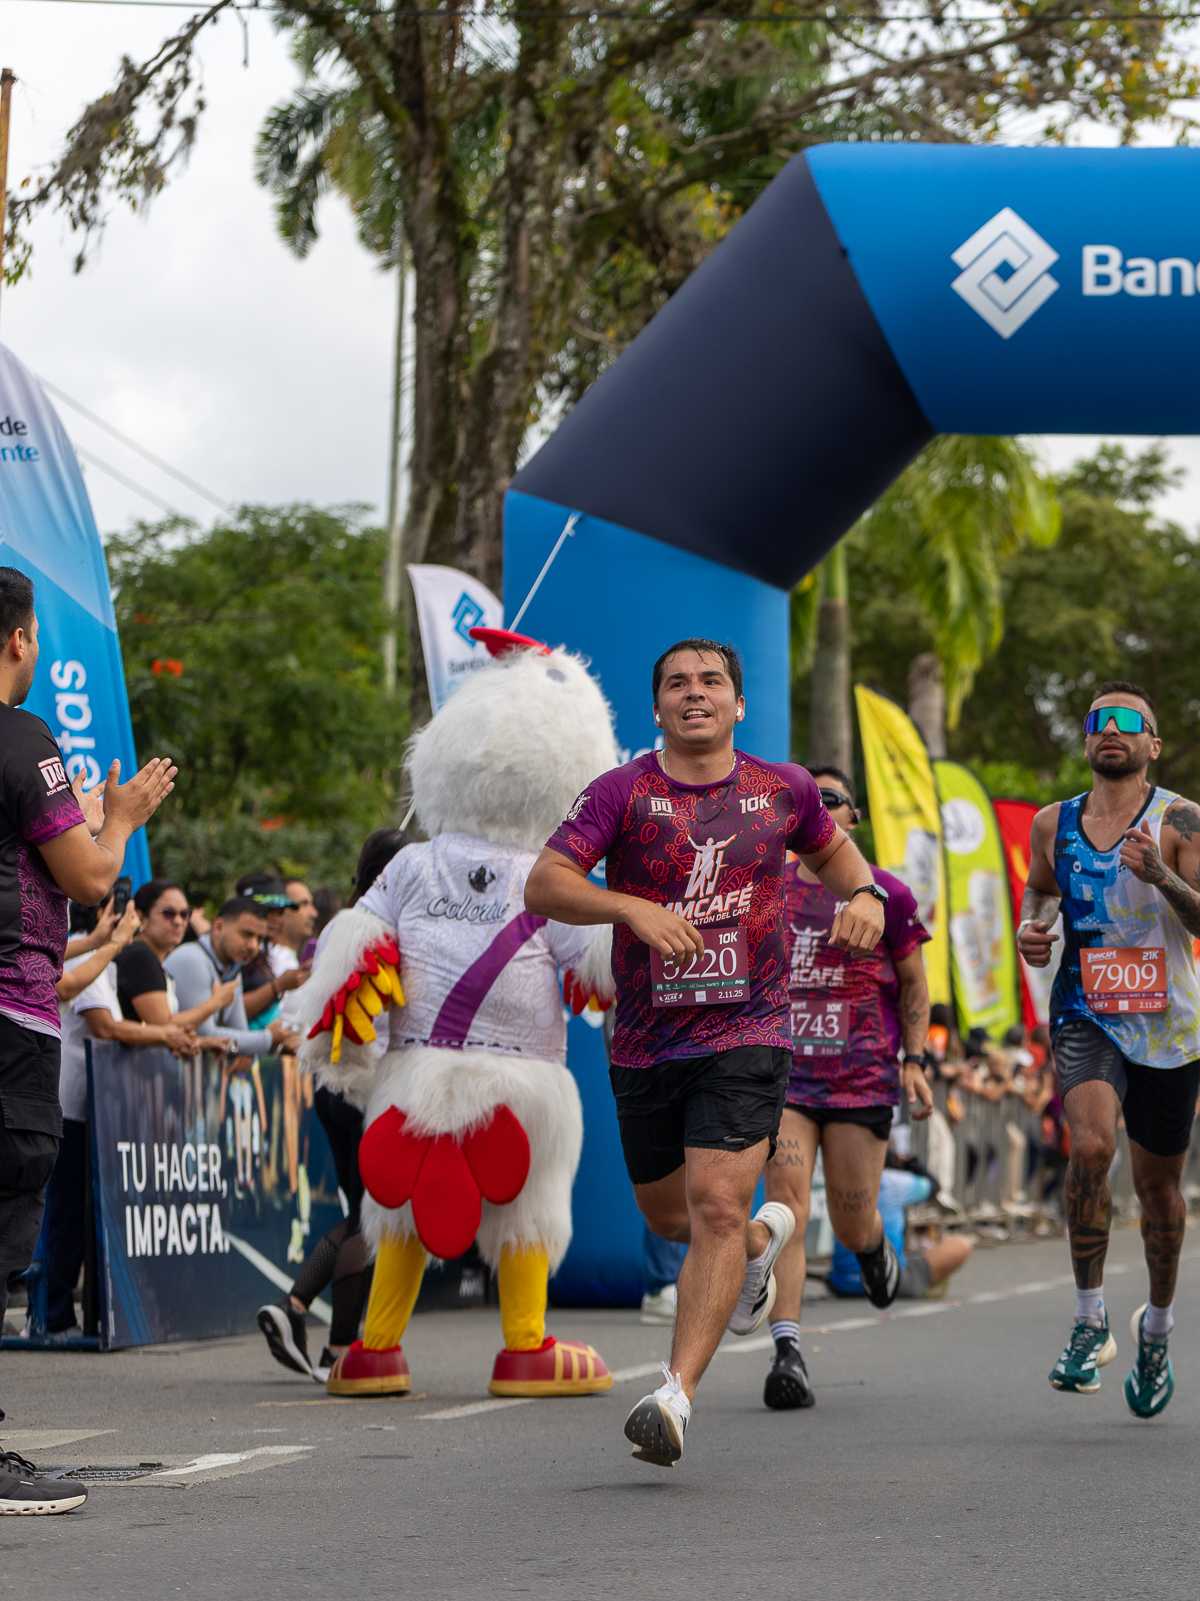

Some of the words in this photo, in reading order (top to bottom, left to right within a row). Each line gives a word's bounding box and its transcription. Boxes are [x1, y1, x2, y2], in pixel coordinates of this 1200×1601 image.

[740, 793, 770, 814] 10K
[716, 911, 731, 921] DEL
[732, 904, 751, 917] CAFÉ
[718, 931, 738, 944] 10K
[1091, 963, 1158, 991] 7909
[718, 989, 743, 999] 2.11.25
[117, 1141, 147, 1192] TU
[154, 1142, 228, 1199] HACER,
[126, 1203, 230, 1257] IMPACTA.
